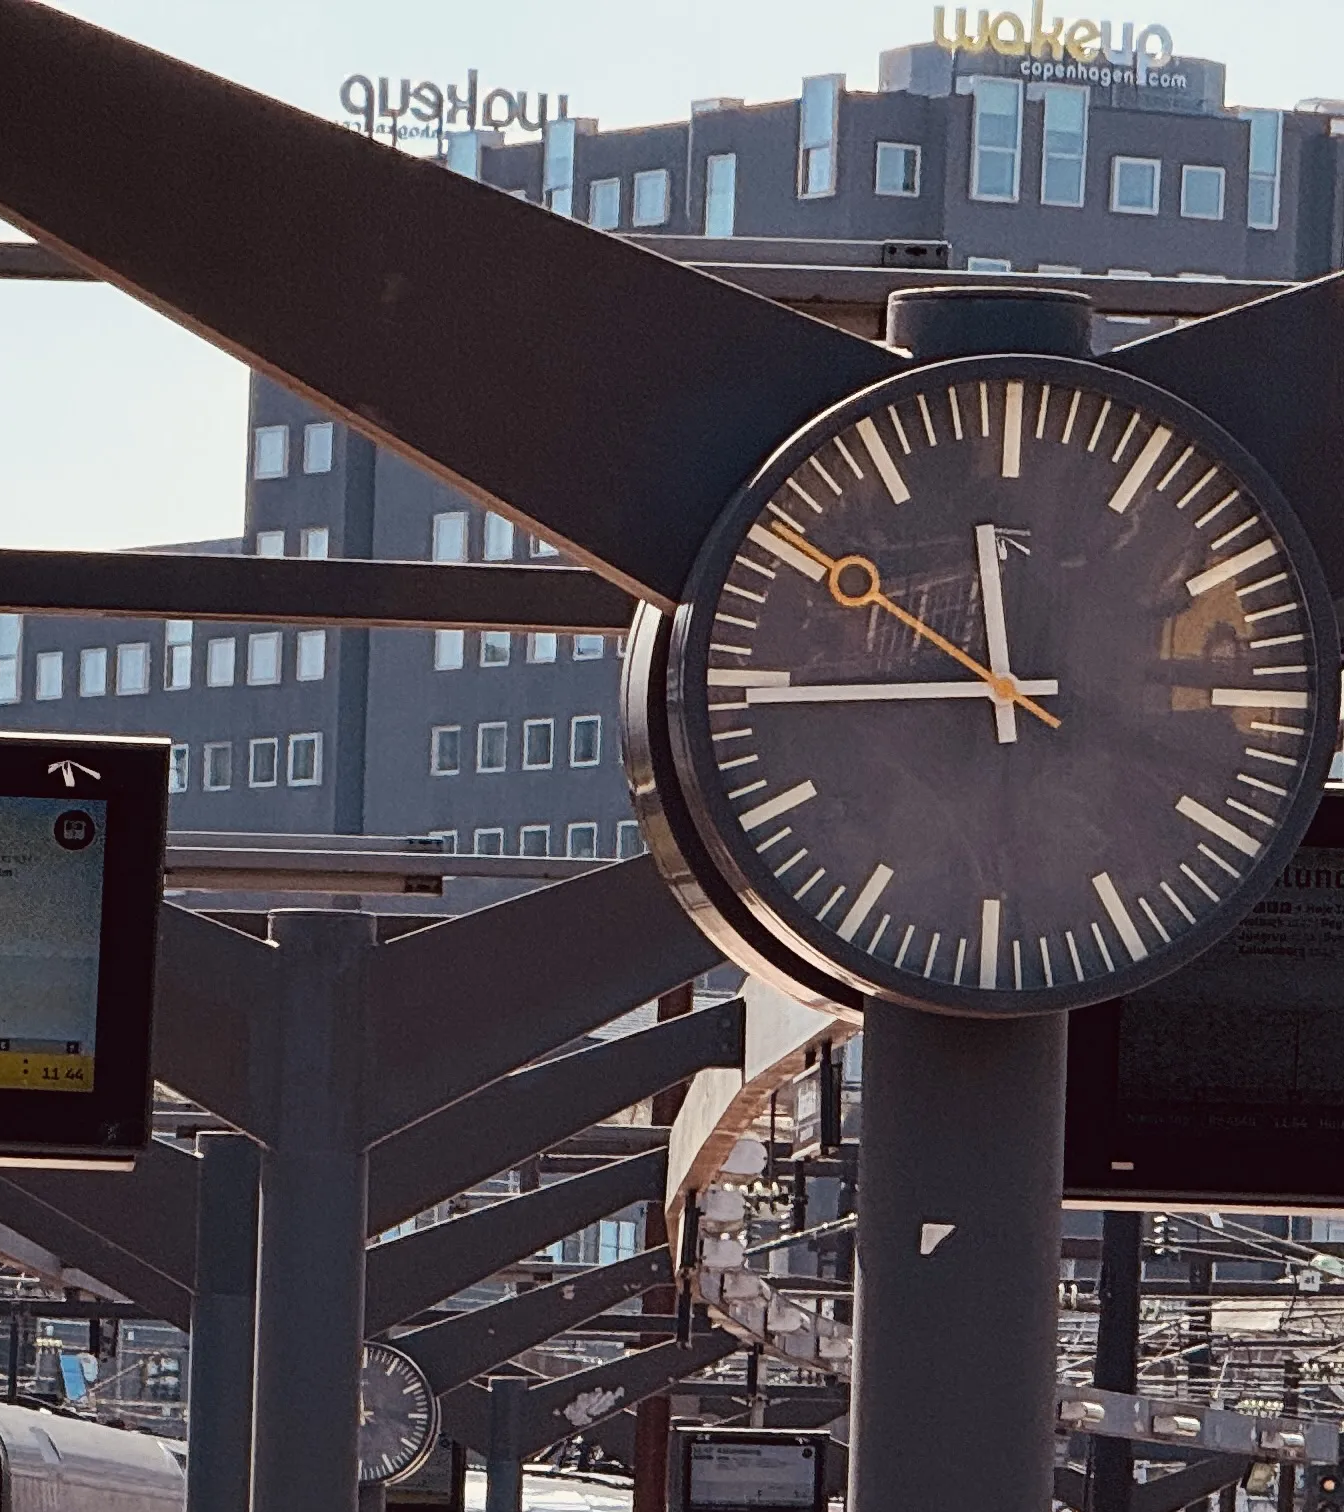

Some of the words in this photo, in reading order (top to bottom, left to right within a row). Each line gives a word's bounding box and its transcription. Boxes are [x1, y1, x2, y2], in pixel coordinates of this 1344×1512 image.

[933, 0, 1173, 84] wakeup
[41, 1067, 61, 1080] 11
[65, 1068, 84, 1080] 44
